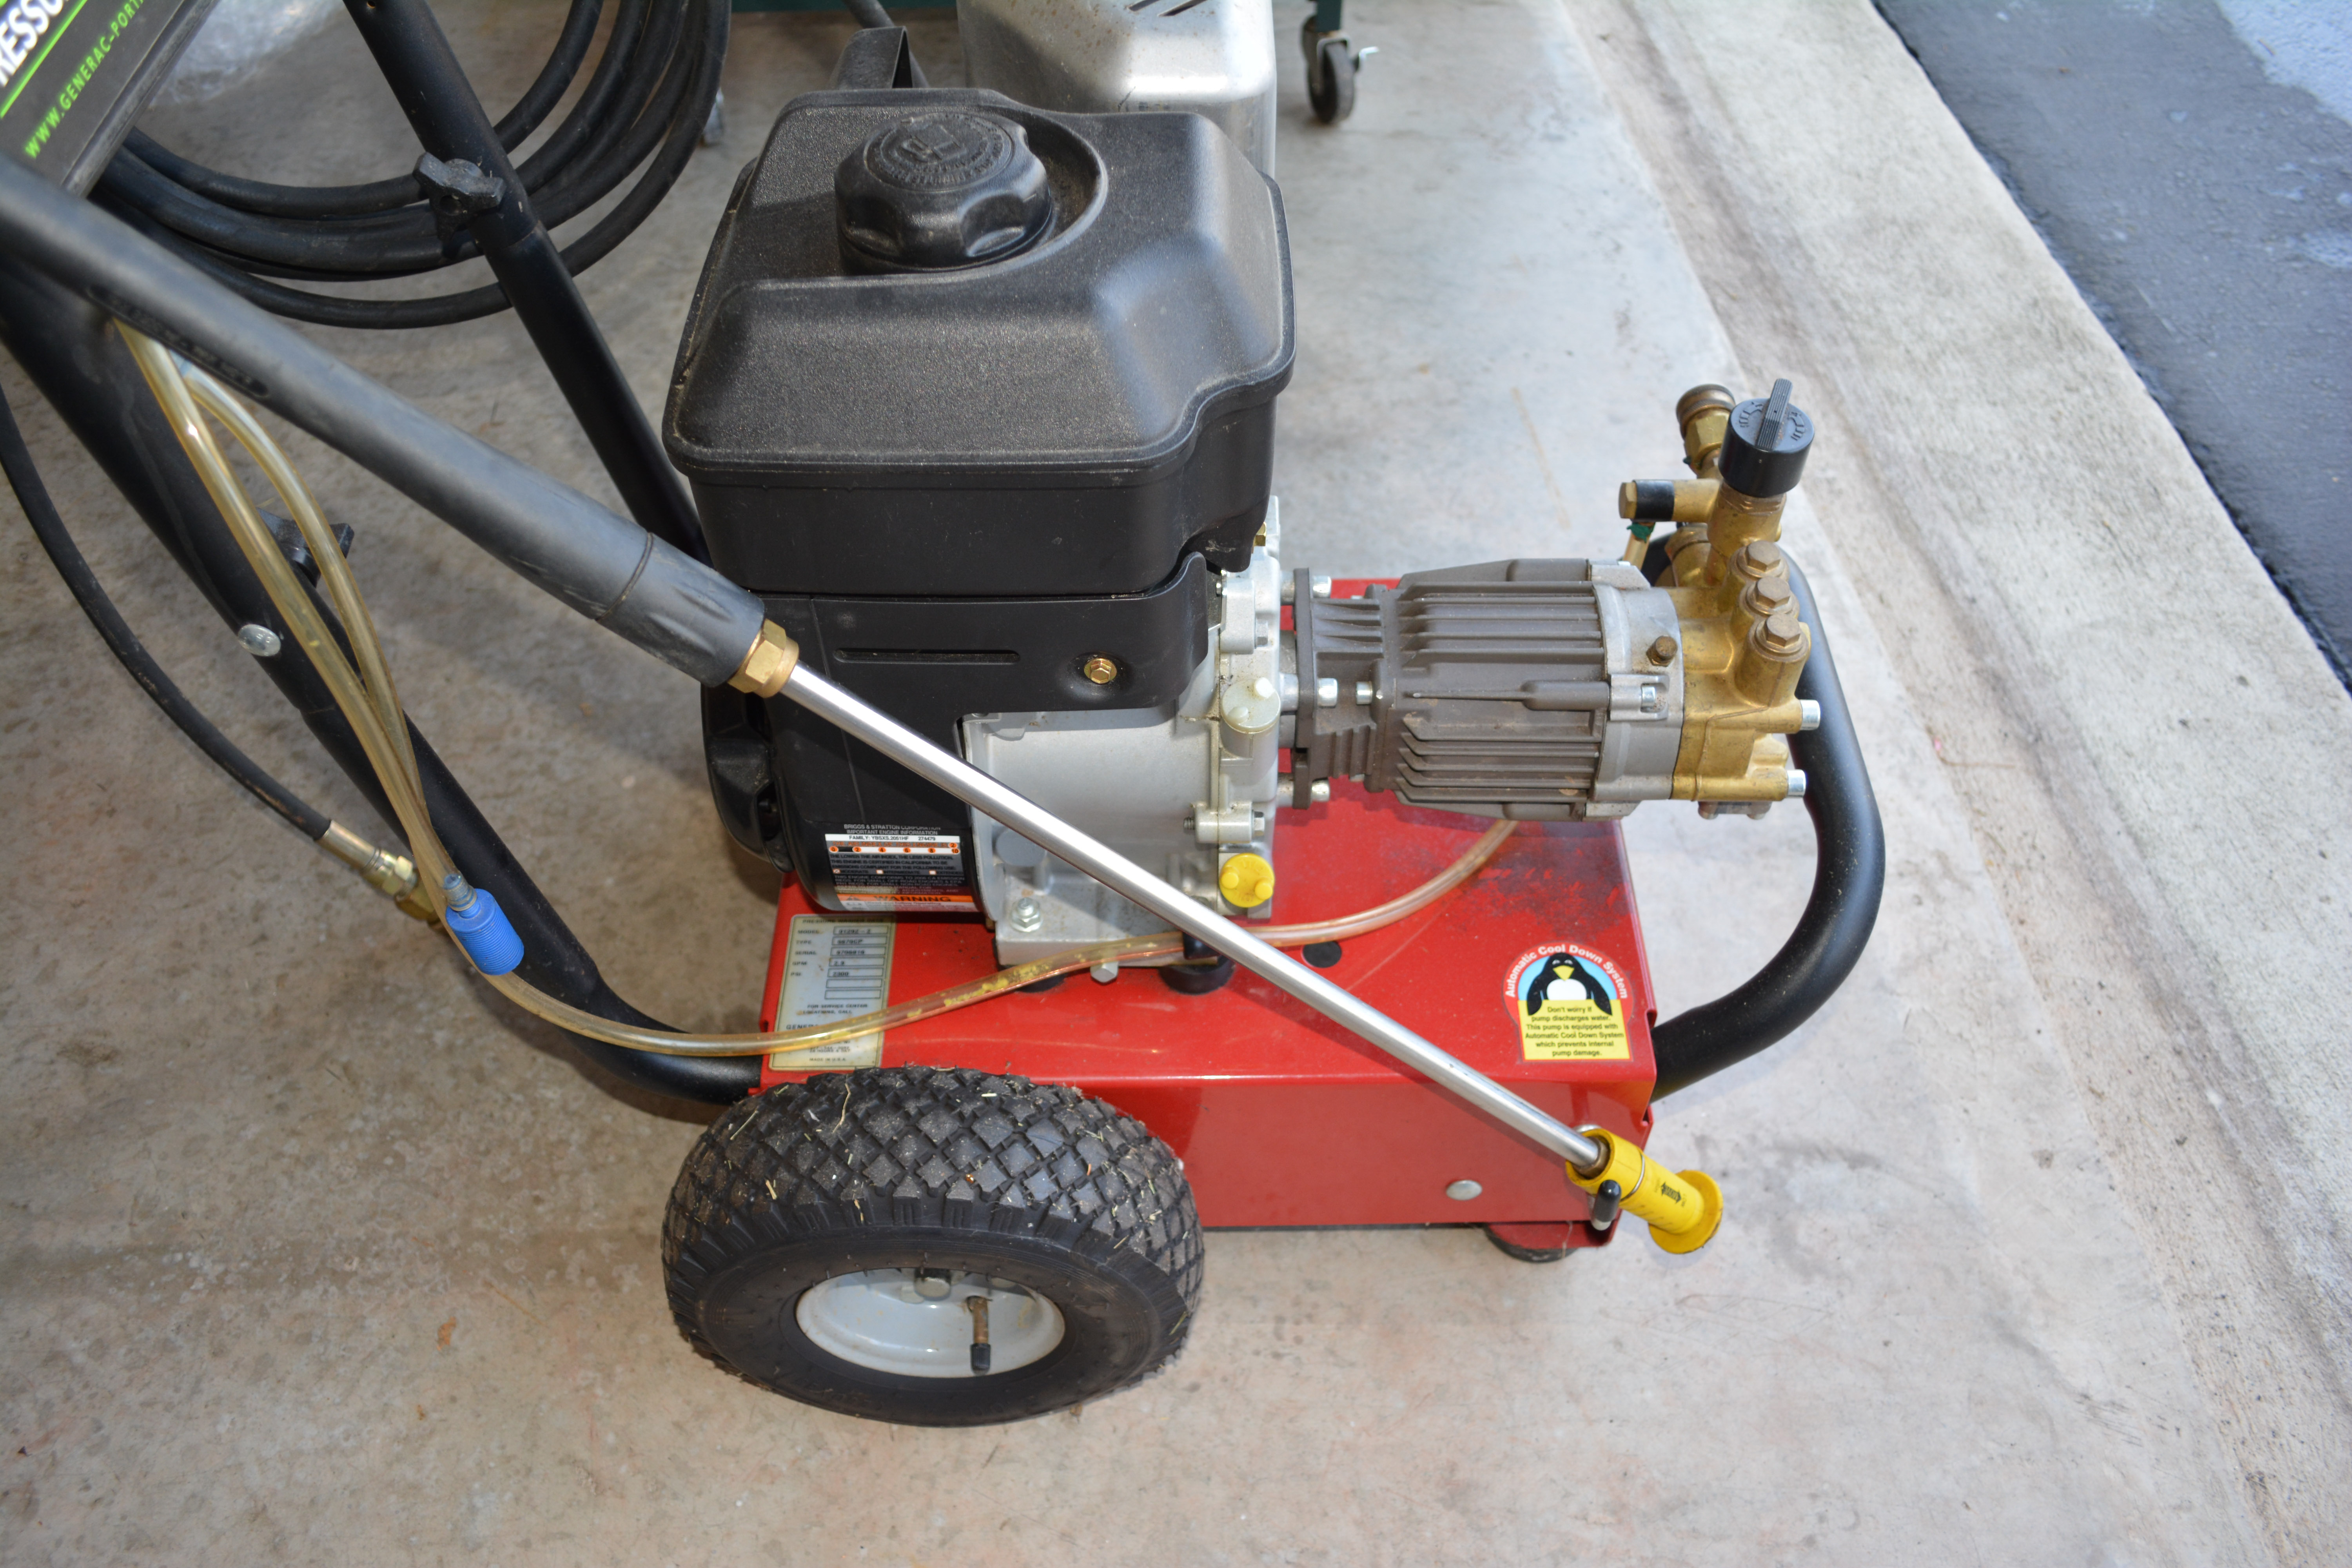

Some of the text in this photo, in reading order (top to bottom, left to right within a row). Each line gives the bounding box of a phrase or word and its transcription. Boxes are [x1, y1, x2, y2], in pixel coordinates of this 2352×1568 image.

[25, 0, 143, 158] WWW.GENERAC-PORT
[1506, 944, 1628, 998] Automatic Cool Down System
